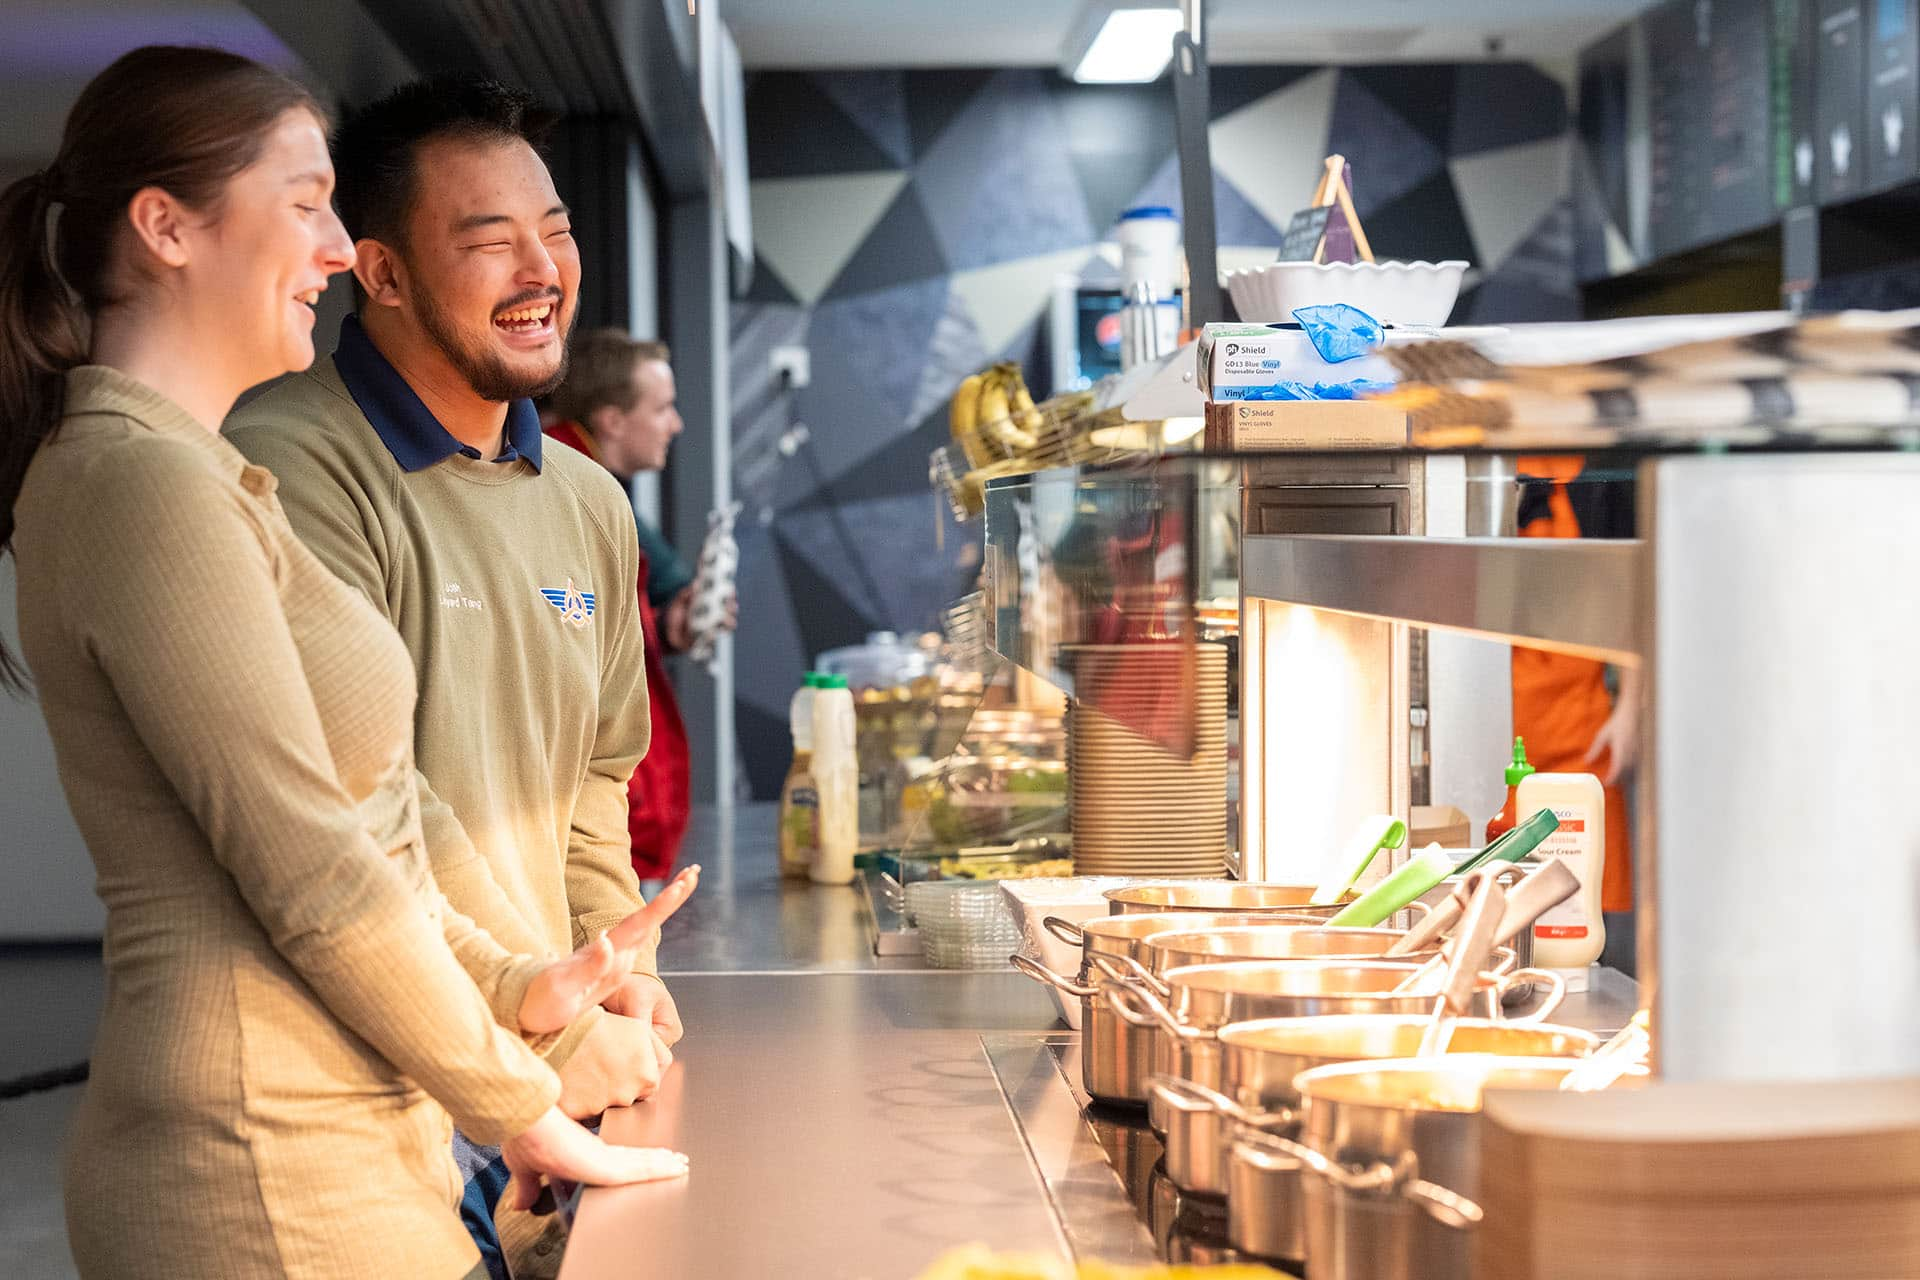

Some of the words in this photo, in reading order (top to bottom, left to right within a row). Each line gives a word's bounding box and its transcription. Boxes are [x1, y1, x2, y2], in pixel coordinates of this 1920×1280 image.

[1241, 346, 1266, 354] Shield
[1244, 360, 1259, 368] Blue
[1262, 360, 1280, 369] Vinyl
[1224, 389, 1245, 399] Vinyl
